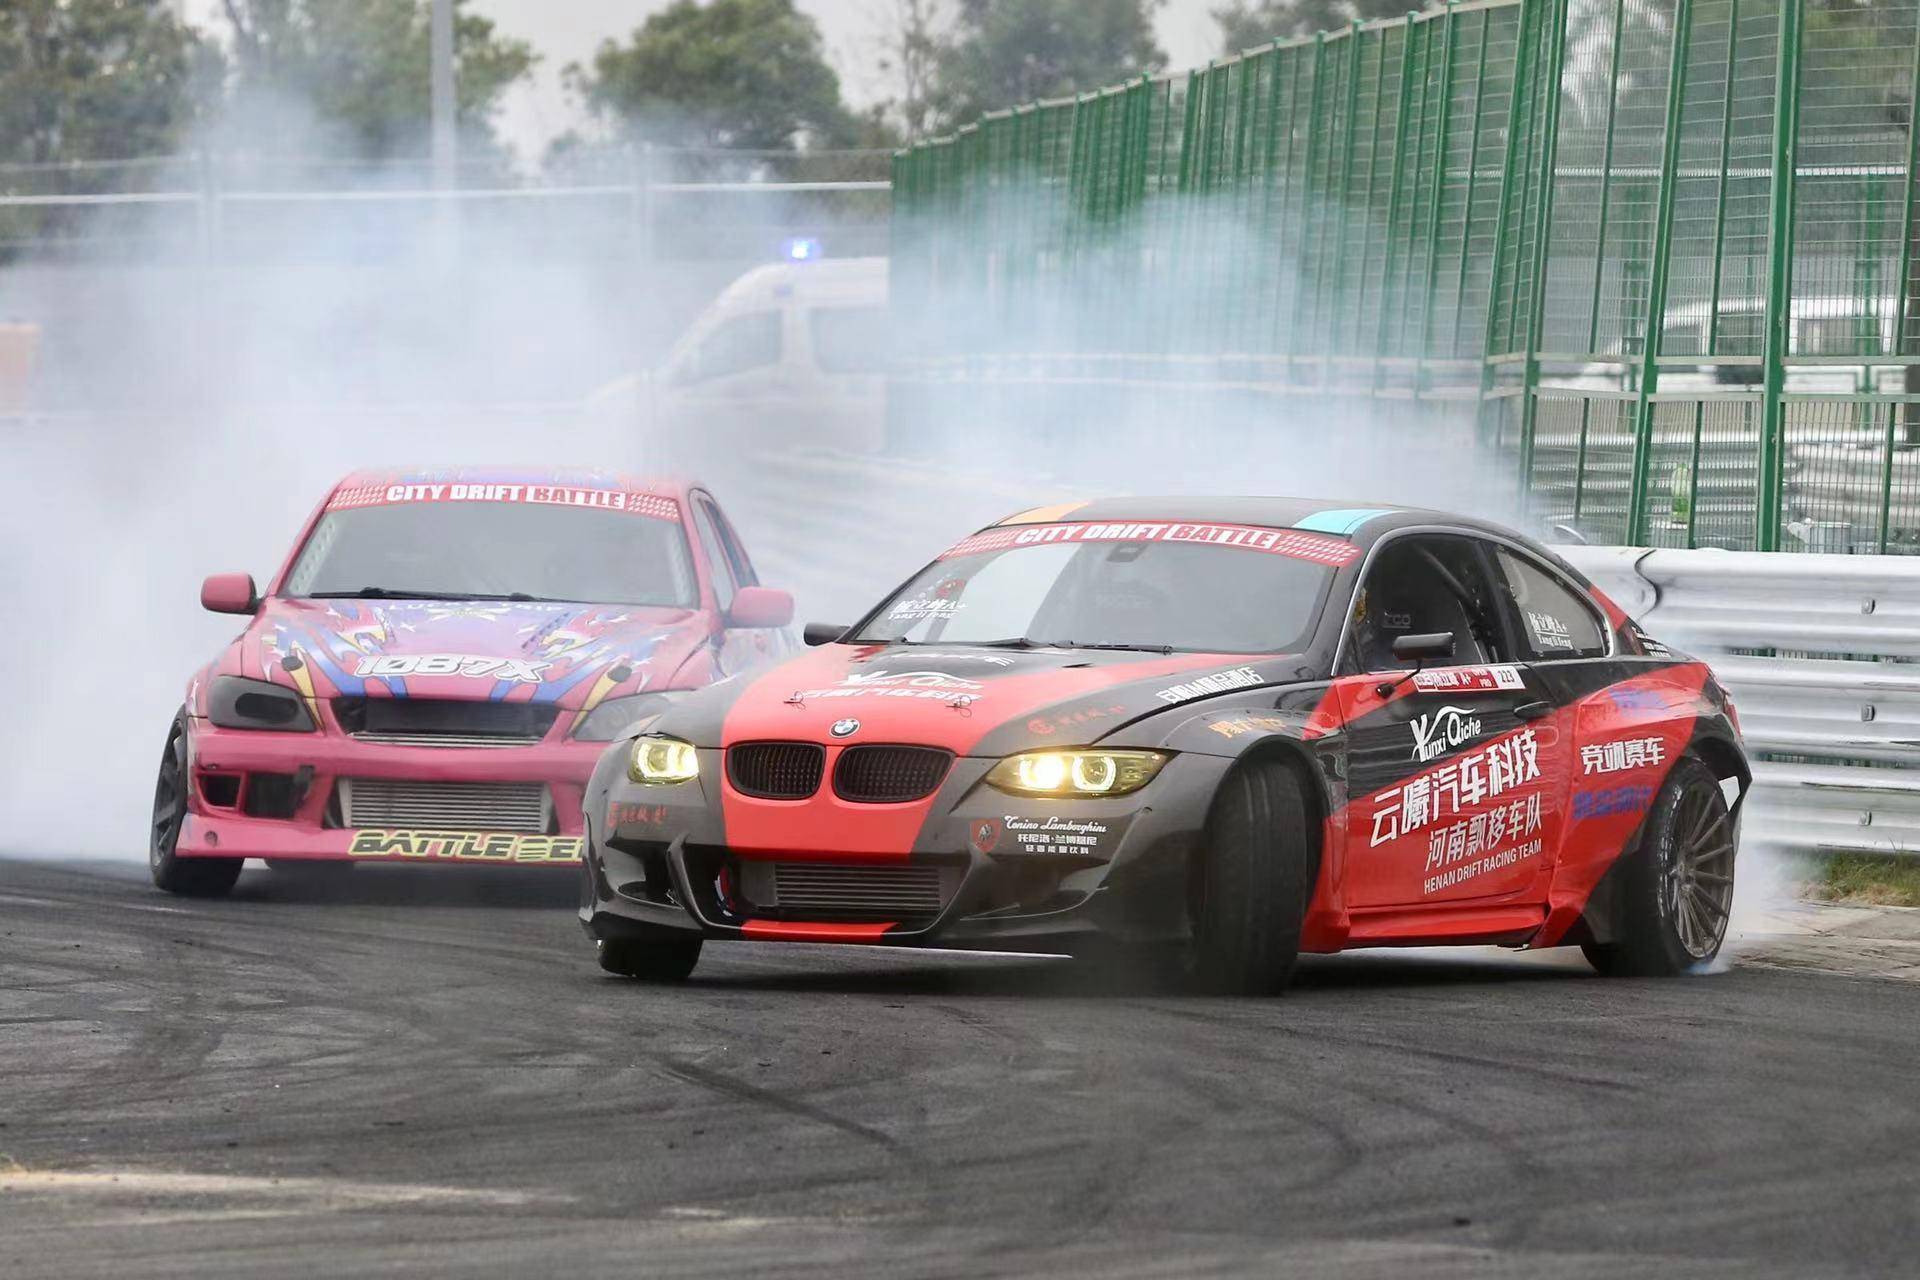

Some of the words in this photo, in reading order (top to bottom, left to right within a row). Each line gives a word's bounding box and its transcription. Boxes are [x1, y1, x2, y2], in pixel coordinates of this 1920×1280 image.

[386, 485, 449, 501] CITY
[449, 485, 524, 501] DRIFT
[533, 487, 625, 509] BATTLE
[1015, 526, 1082, 544] CITY
[1081, 524, 1169, 540] DRIFT
[1174, 526, 1275, 548] BATTLE
[354, 653, 554, 683] 1087X
[1410, 710, 1447, 763] Yunxi
[1447, 712, 1481, 746] Qiche
[1370, 728, 1541, 848] 云曦汽车科技
[349, 829, 518, 859] BATTLE
[1425, 791, 1542, 872] 河南飘移车队
[1424, 870, 1456, 895] HENAN
[1457, 860, 1482, 882] DRIFT
[1483, 848, 1517, 873] RACING
[1518, 838, 1542, 859] TEAM
